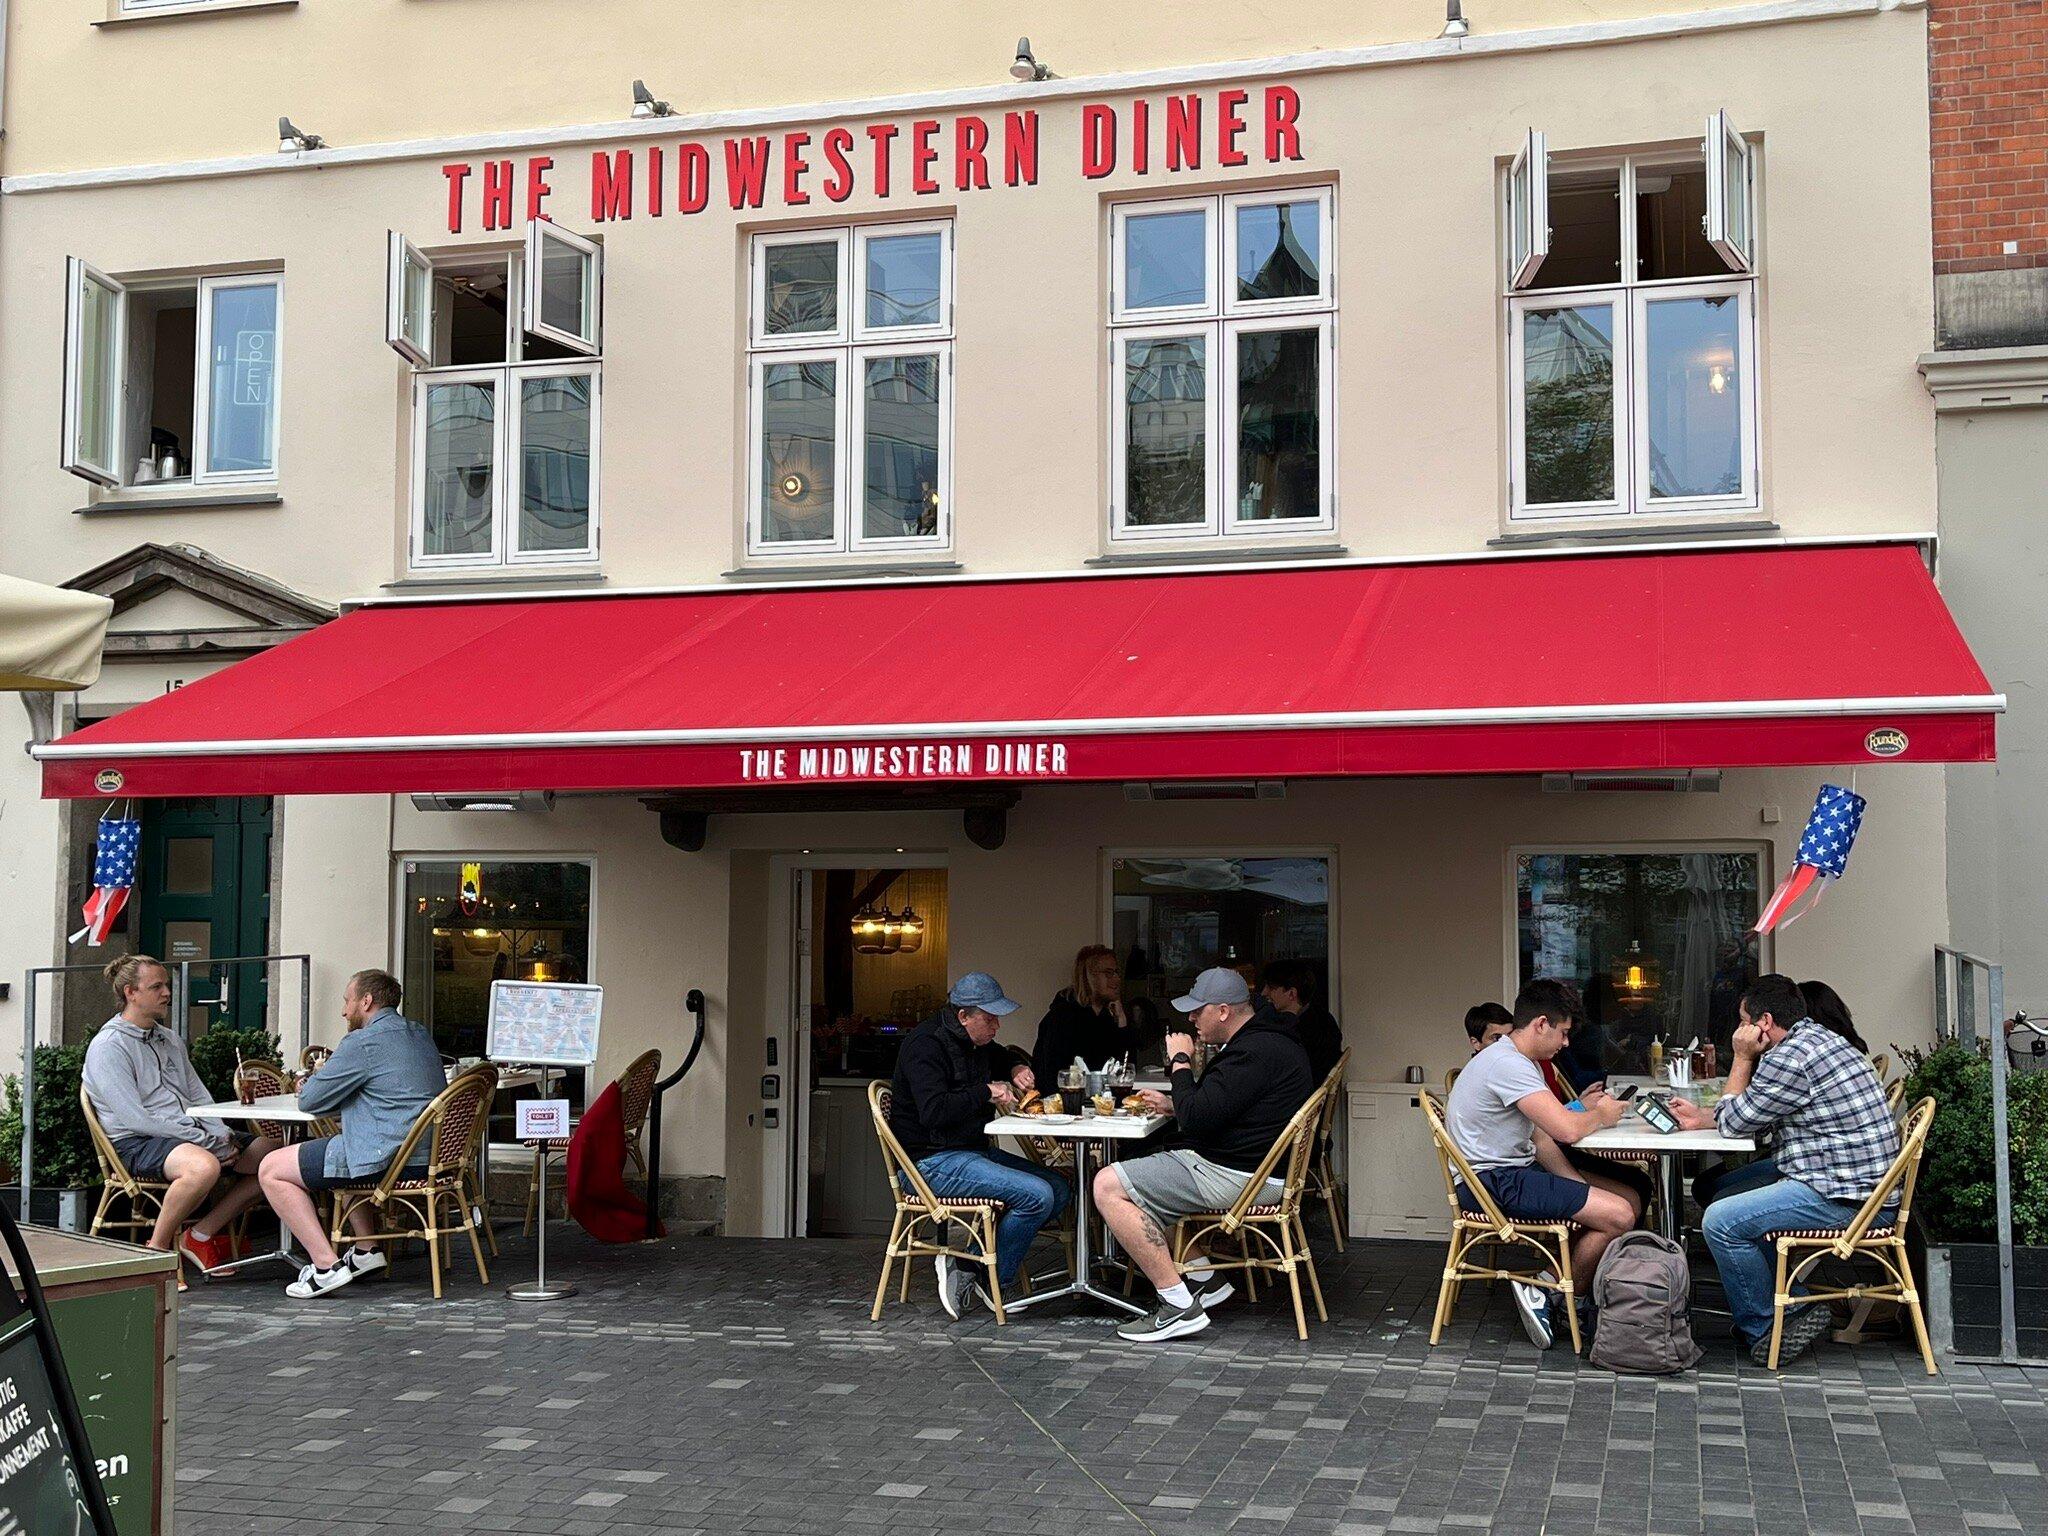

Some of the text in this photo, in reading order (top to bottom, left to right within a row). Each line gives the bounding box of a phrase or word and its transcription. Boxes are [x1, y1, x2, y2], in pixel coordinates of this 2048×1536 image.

[443, 85, 1304, 233] THE MIDWESTERN DINER
[740, 743, 1068, 780] THE MIDWESTERN DINER
